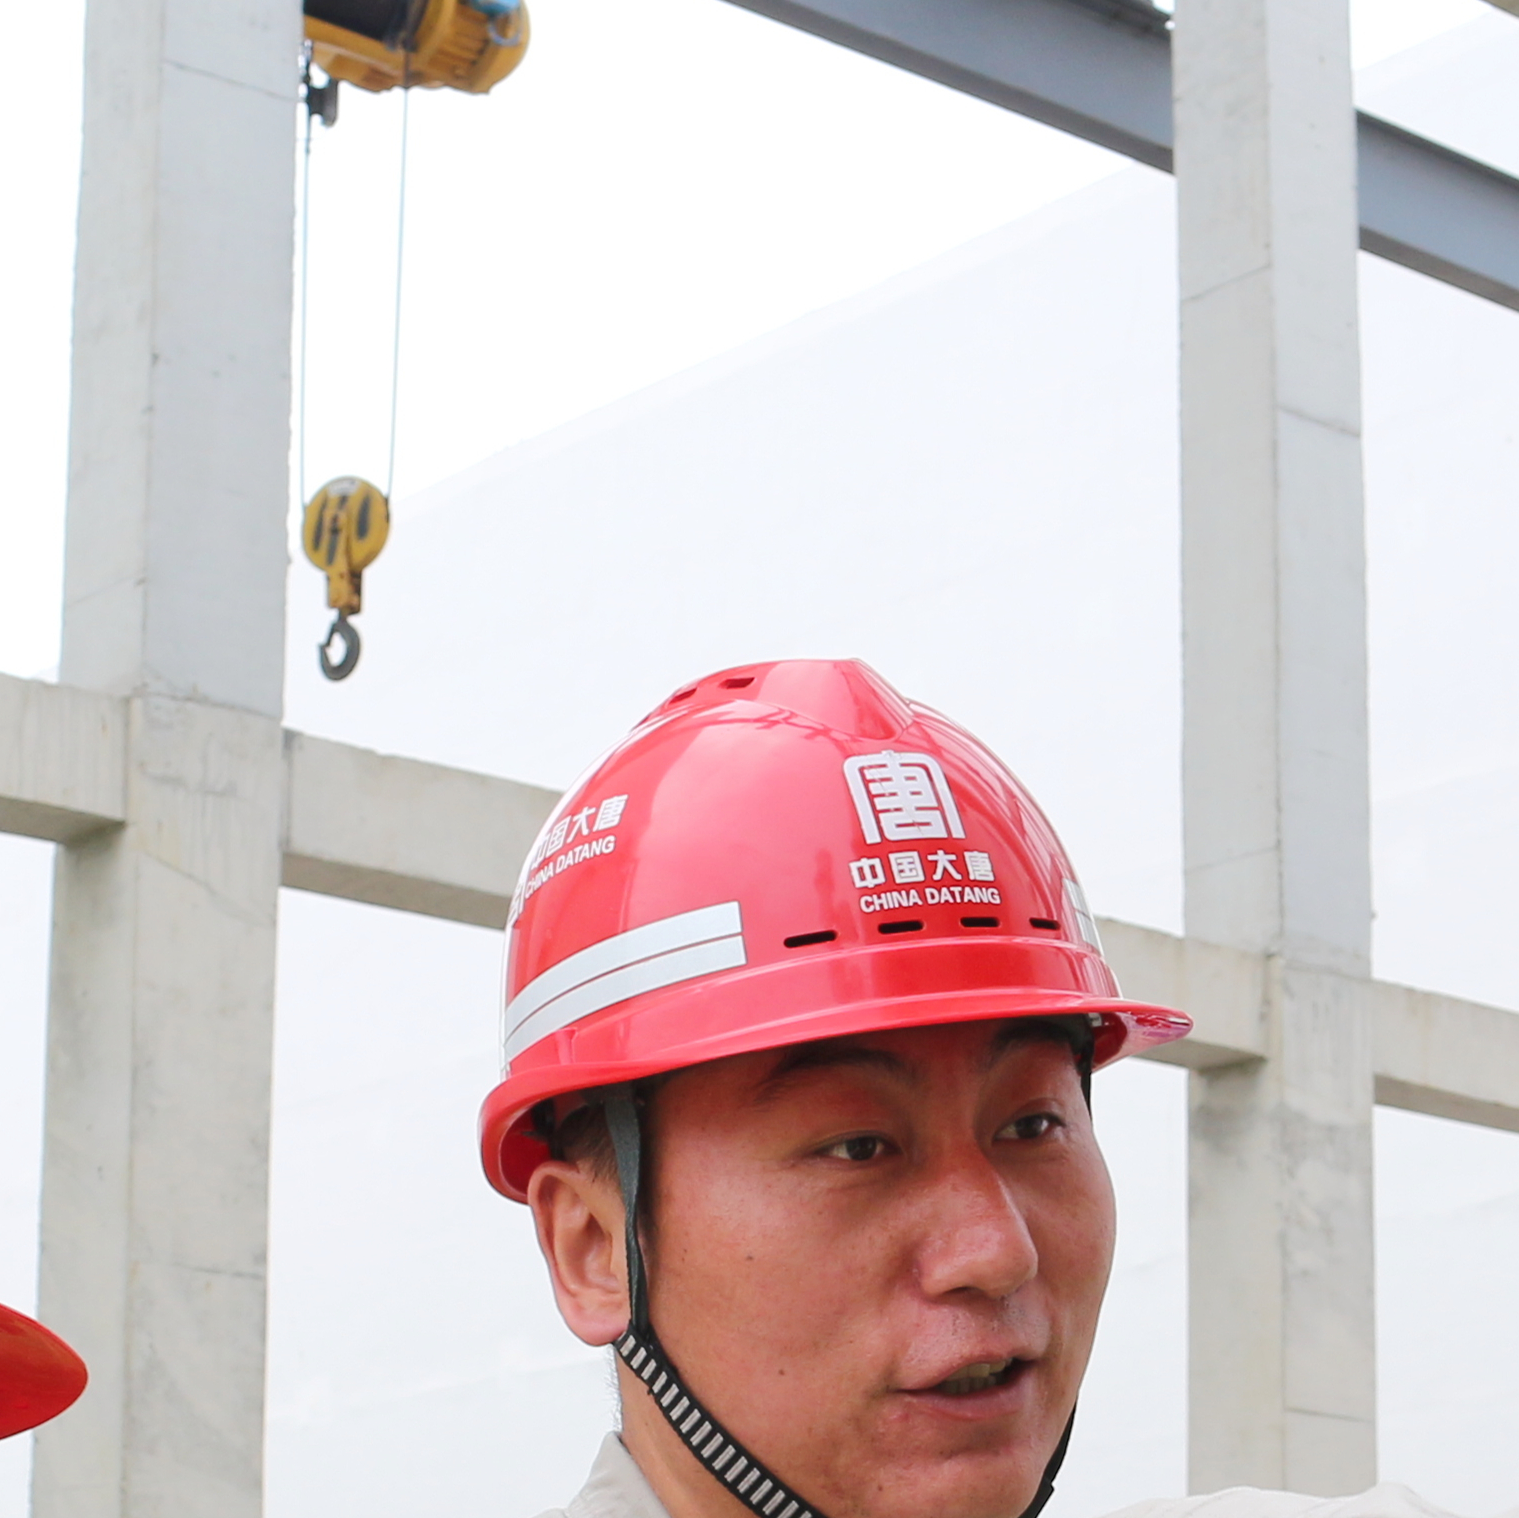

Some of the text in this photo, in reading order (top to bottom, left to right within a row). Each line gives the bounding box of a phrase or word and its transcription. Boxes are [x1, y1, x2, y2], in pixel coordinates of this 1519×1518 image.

[555, 835, 617, 874] DATANG
[848, 849, 996, 888] 中国大唐
[860, 886, 1001, 913] CHINA DATANG
